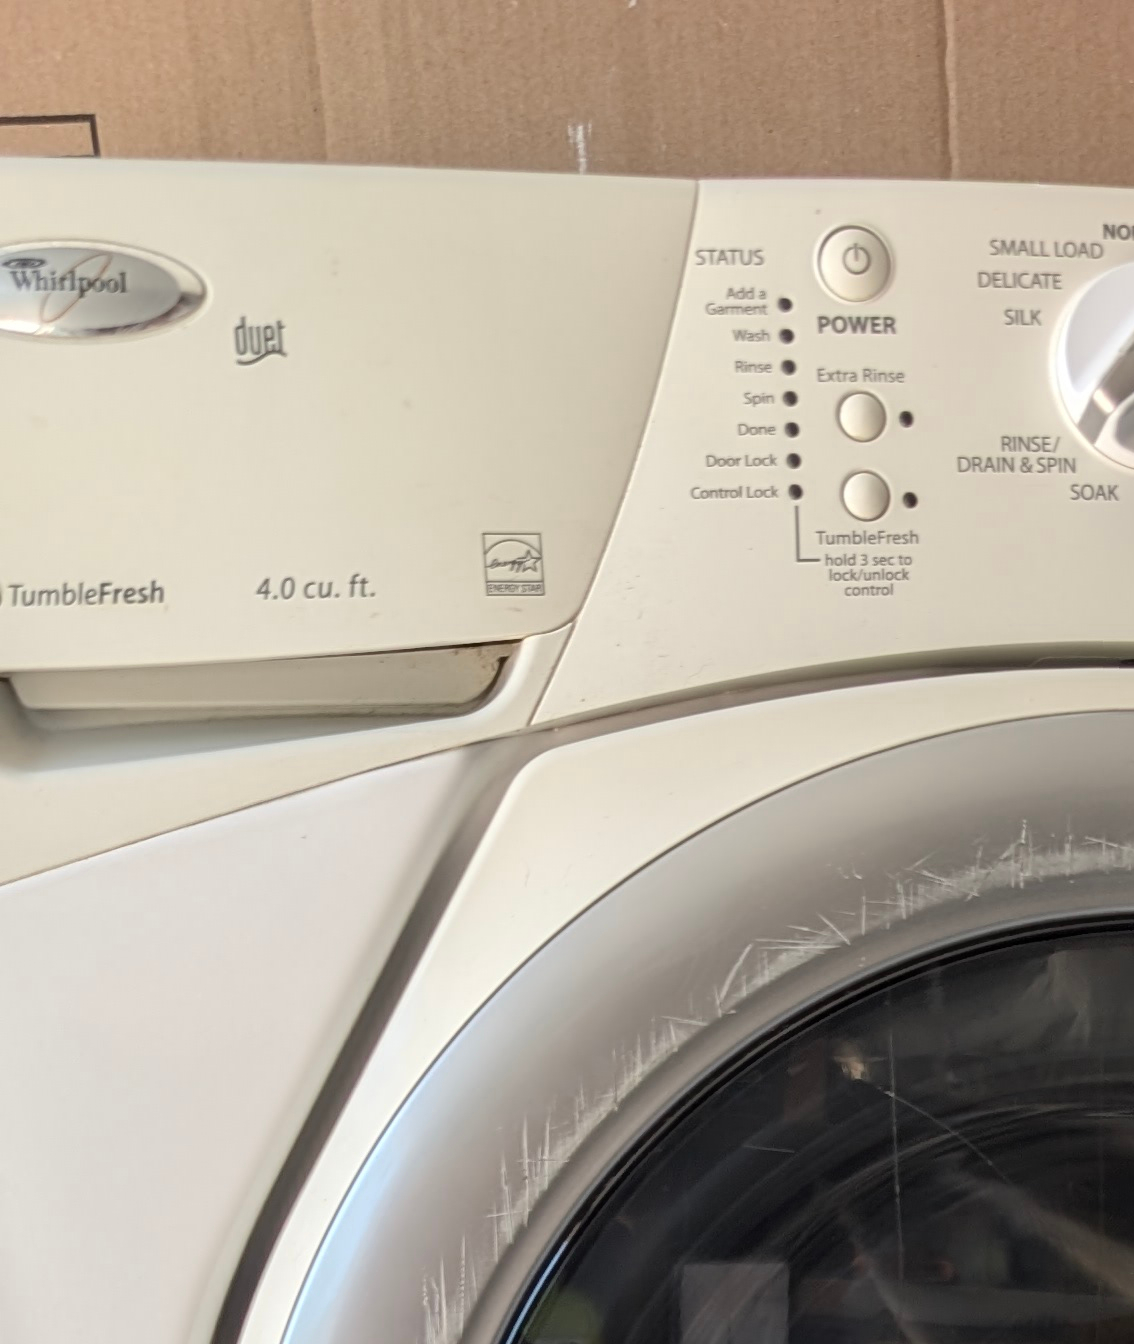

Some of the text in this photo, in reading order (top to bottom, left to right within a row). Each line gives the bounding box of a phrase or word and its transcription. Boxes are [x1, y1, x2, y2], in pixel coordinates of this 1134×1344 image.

[990, 240, 1104, 259] SMALL LOAD
[695, 249, 764, 266] STATUS
[9, 269, 128, 299] Whirlpool
[977, 271, 1062, 290] DELICATE
[726, 288, 767, 299] Add a
[705, 303, 768, 316] Garment
[1004, 309, 1041, 326] SILK
[817, 316, 896, 334] POWER
[235, 316, 287, 366] duet
[733, 330, 770, 342] Wash
[735, 361, 772, 373] Rinse
[817, 369, 905, 382] Extra Rinse
[744, 392, 774, 406] Spin
[738, 424, 775, 436] Done
[1001, 436, 1060, 453] RINSE/
[706, 455, 777, 467] Door Lock
[957, 457, 1076, 474] DRAIN & SPIN
[691, 485, 778, 499] Control Lock
[1070, 484, 1119, 501] SOAK
[816, 531, 919, 545] TumbleFresh
[825, 554, 912, 566] hold 3 sec to
[829, 569, 909, 581] lock/unlock
[8, 580, 165, 607] TumbleFresh
[256, 575, 376, 601] 4.0 cu. ft.
[844, 584, 894, 596] control
